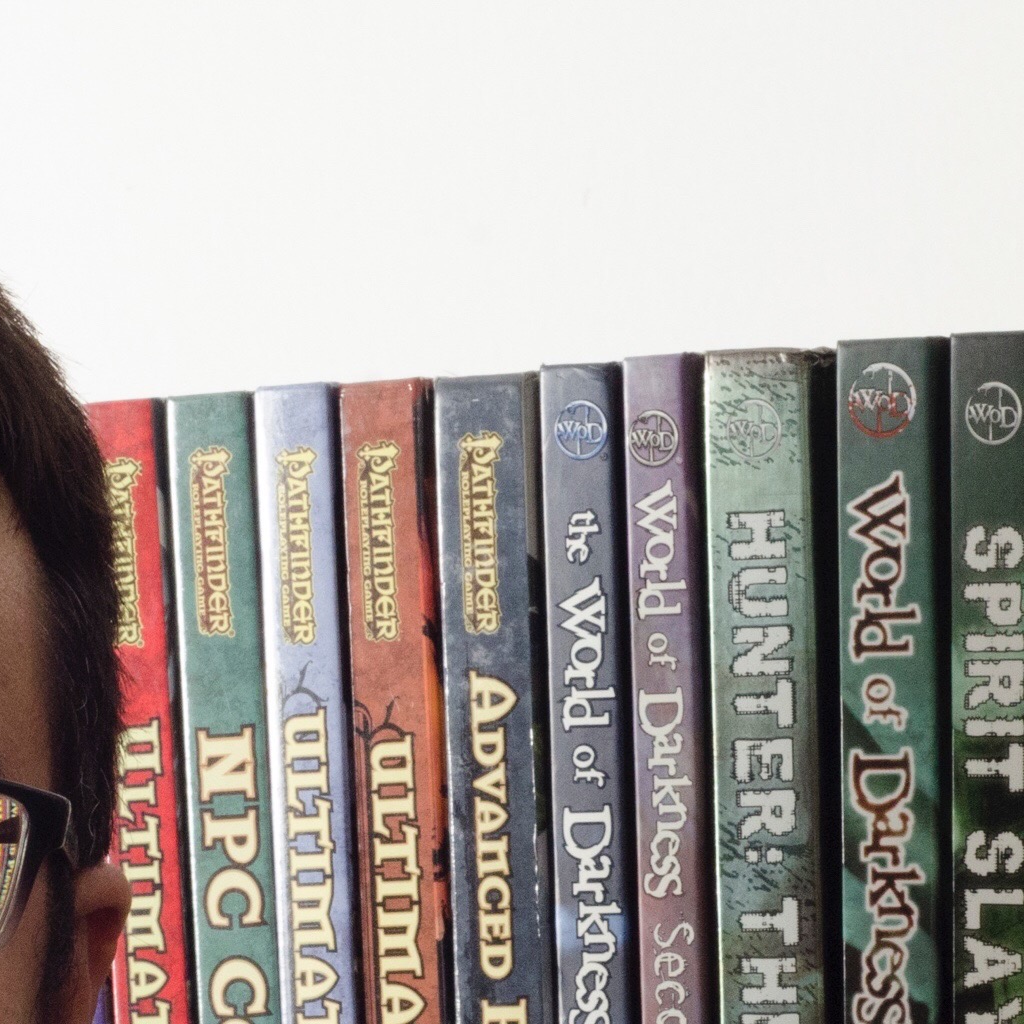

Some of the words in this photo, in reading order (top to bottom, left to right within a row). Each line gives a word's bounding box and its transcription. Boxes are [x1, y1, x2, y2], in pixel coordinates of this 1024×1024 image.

[191, 483, 204, 573] ROLEPLAYING
[191, 450, 230, 635] PATHFINDER
[277, 447, 317, 644] PATHFINDER
[278, 484, 290, 581] ROLEPLAYING
[359, 480, 372, 576] ROLEPLAYING
[359, 443, 400, 640] PATHFINDER
[461, 471, 473, 568] ROLEPLAYING
[461, 433, 503, 634] PATHFINDER
[564, 509, 602, 563] the
[634, 479, 686, 620] World
[847, 471, 921, 662] World
[196, 577, 207, 616] GAME
[281, 584, 291, 627] GAME
[363, 580, 374, 623] GAME
[464, 571, 475, 616] GAME
[647, 631, 678, 671] of
[556, 576, 616, 732] World
[727, 509, 798, 865] HUNTER:
[863, 676, 907, 730] of
[964, 525, 1024, 792] SPIRIT
[467, 670, 518, 980] ADVANCED
[572, 744, 605, 788] of
[638, 687, 693, 898] Darkness
[196, 726, 268, 929] NPC
